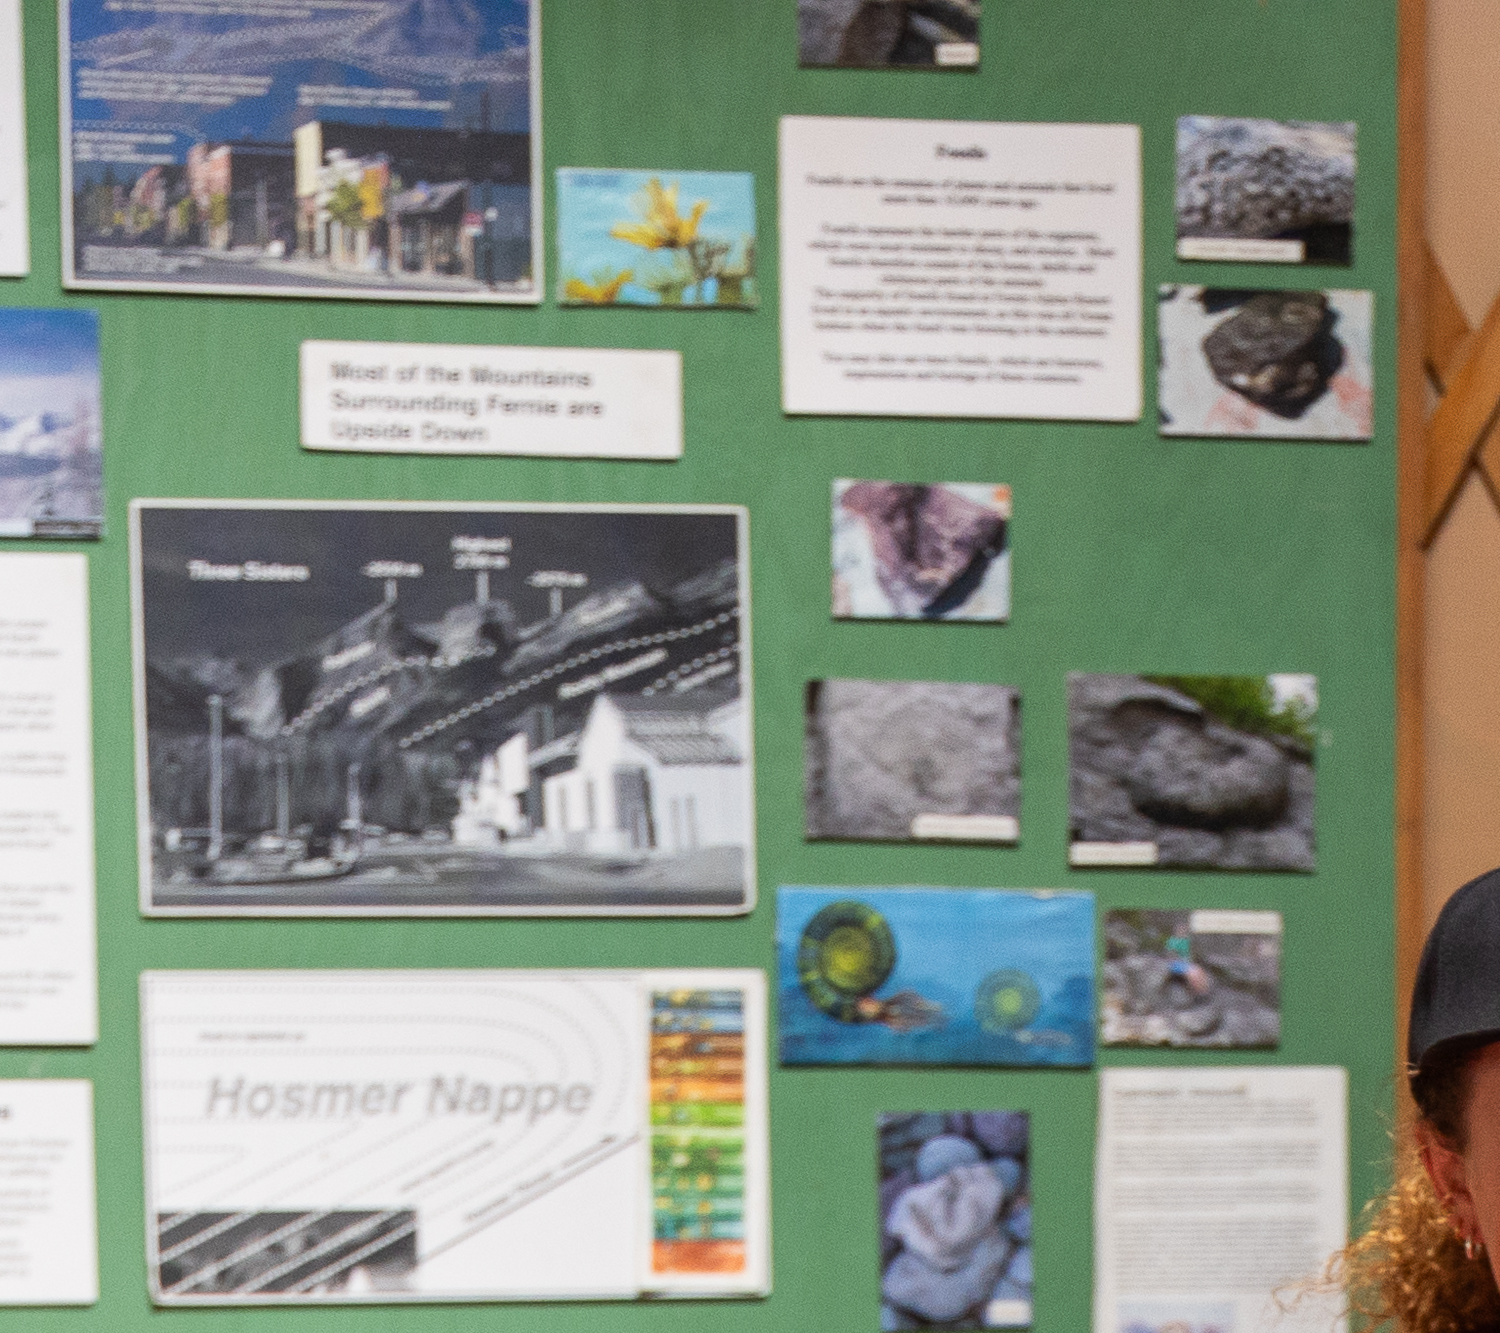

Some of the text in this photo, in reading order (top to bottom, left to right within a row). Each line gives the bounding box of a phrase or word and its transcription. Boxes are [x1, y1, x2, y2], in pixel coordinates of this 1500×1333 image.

[330, 361, 592, 387] Most of the Mountains
[330, 389, 605, 417] Surrounding Fernie are
[330, 420, 489, 443] Upside Down
[204, 1074, 596, 1127] Hosmer Nappe
